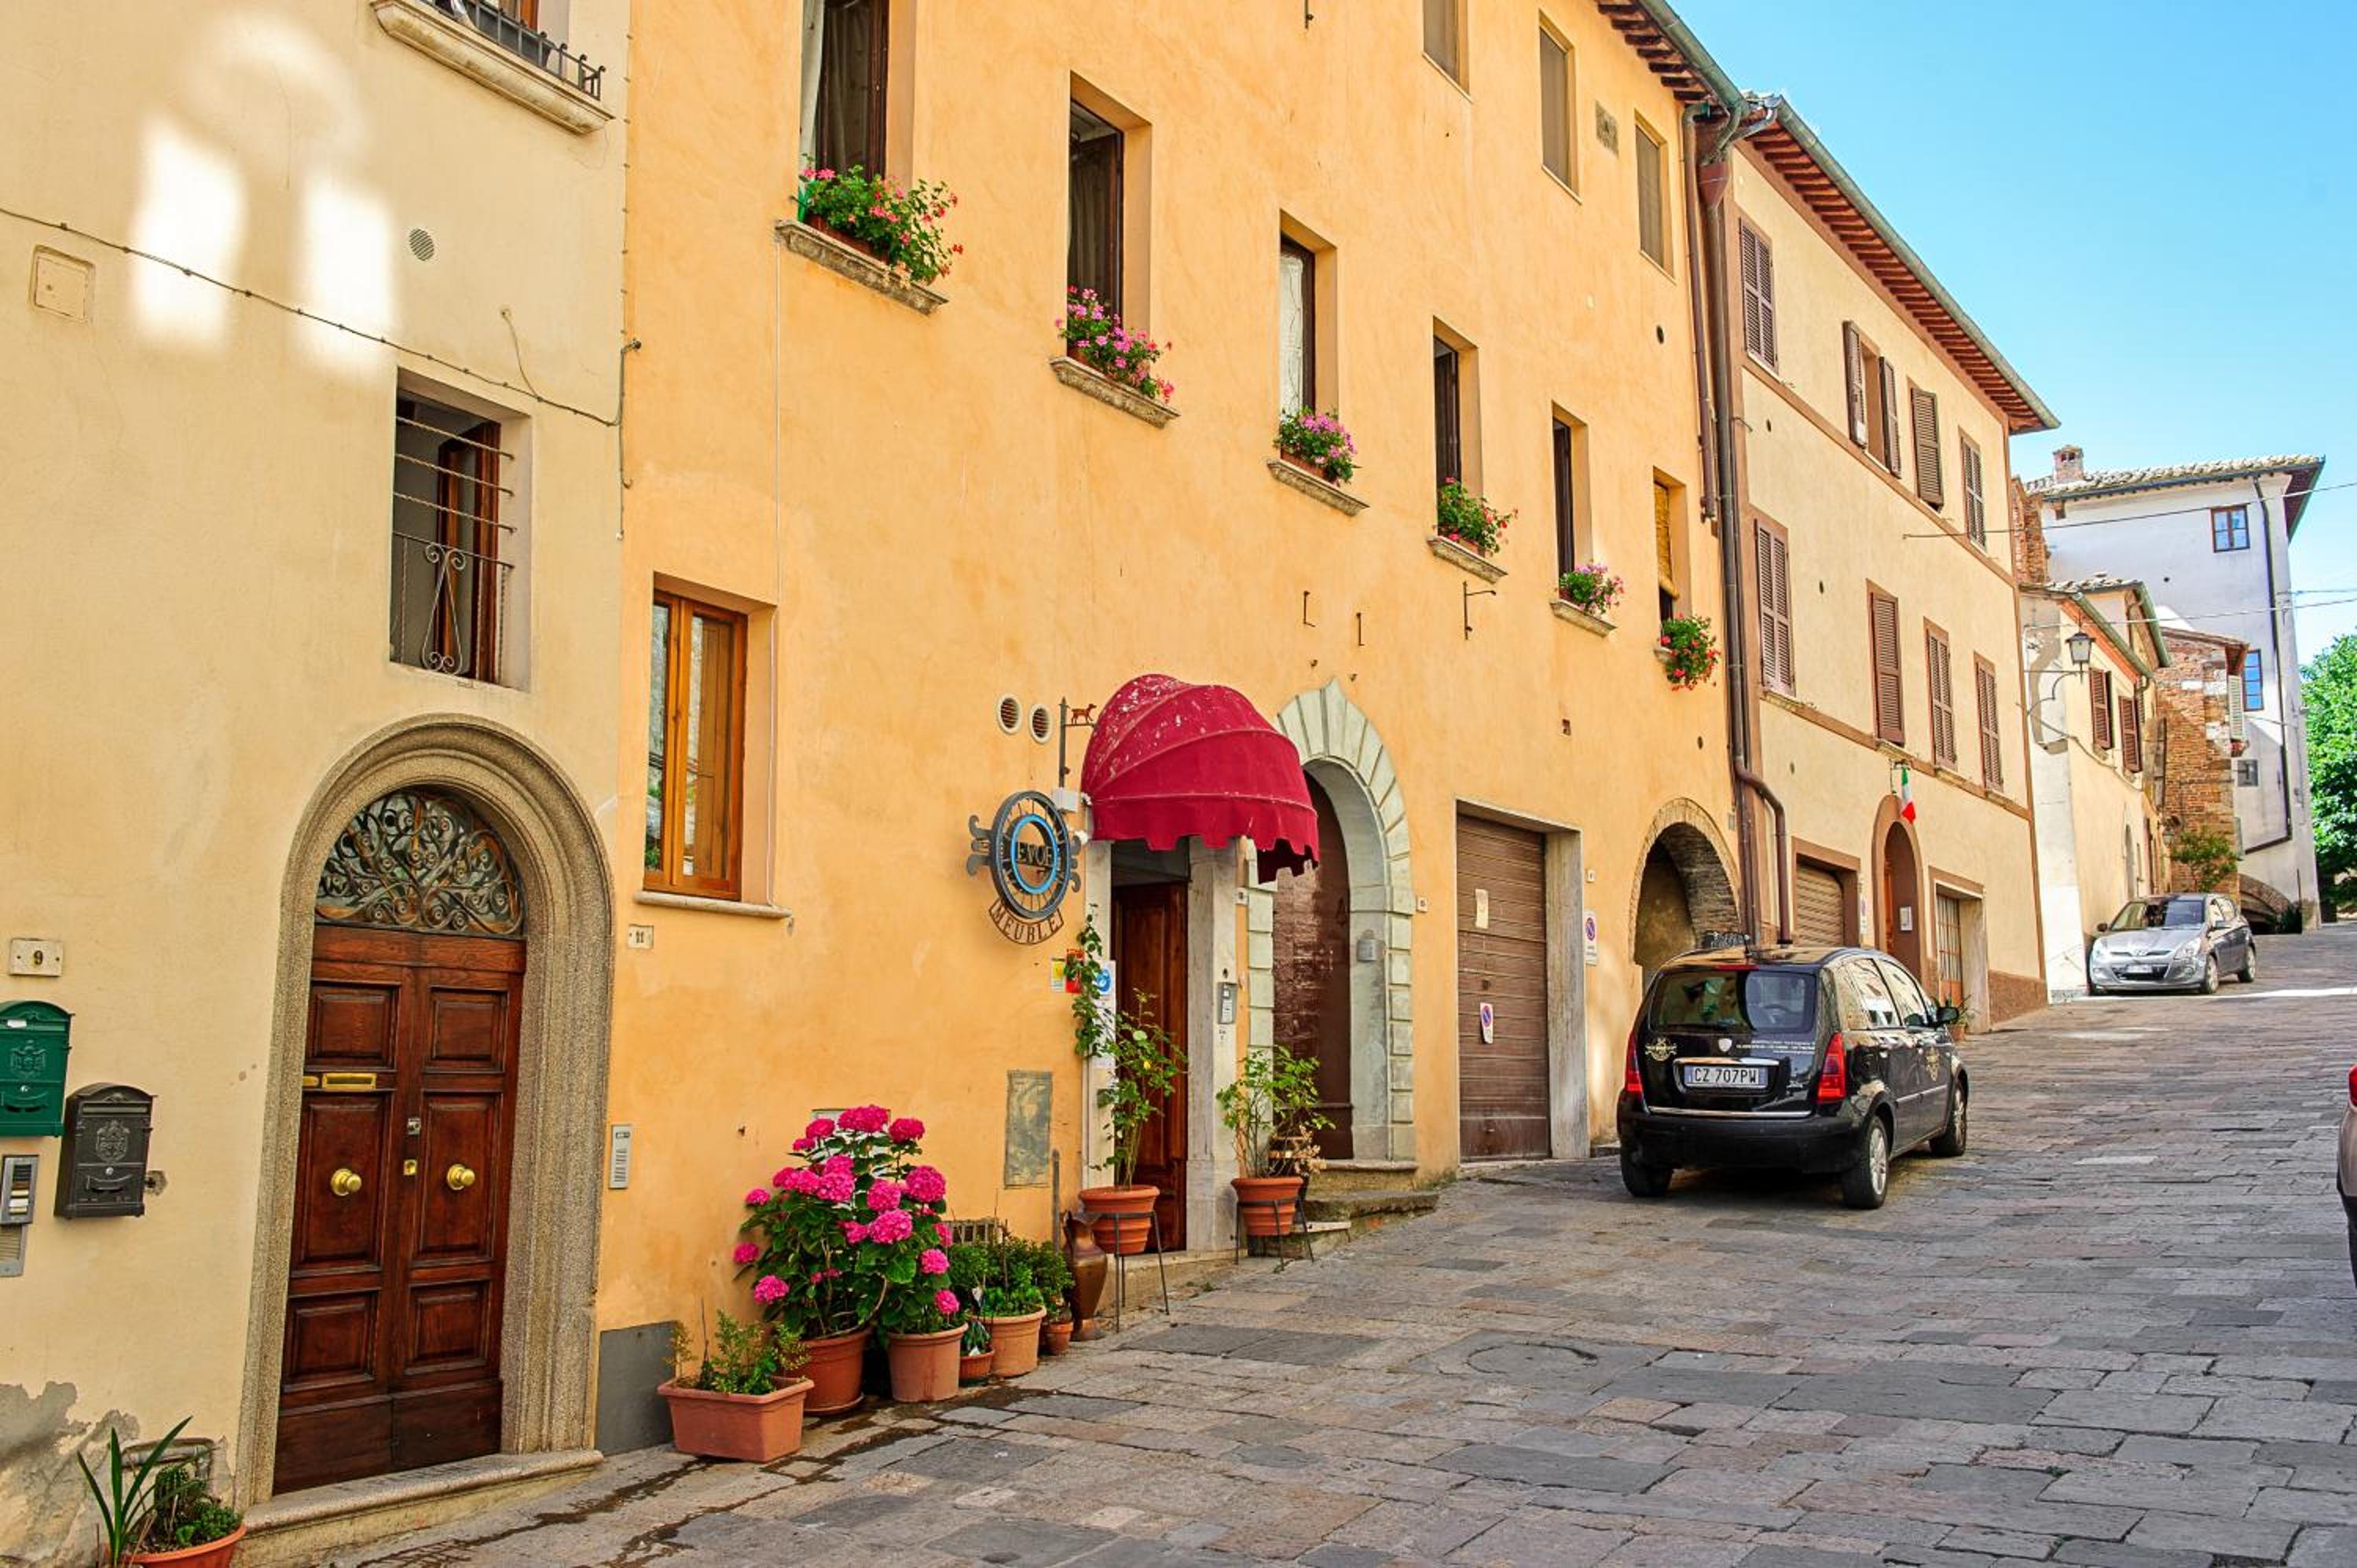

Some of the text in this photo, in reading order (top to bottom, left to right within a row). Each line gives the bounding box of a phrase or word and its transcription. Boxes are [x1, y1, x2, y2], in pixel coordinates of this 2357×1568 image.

[33, 950, 43, 965] 9
[1695, 1068, 1757, 1083] CZ 707PW
